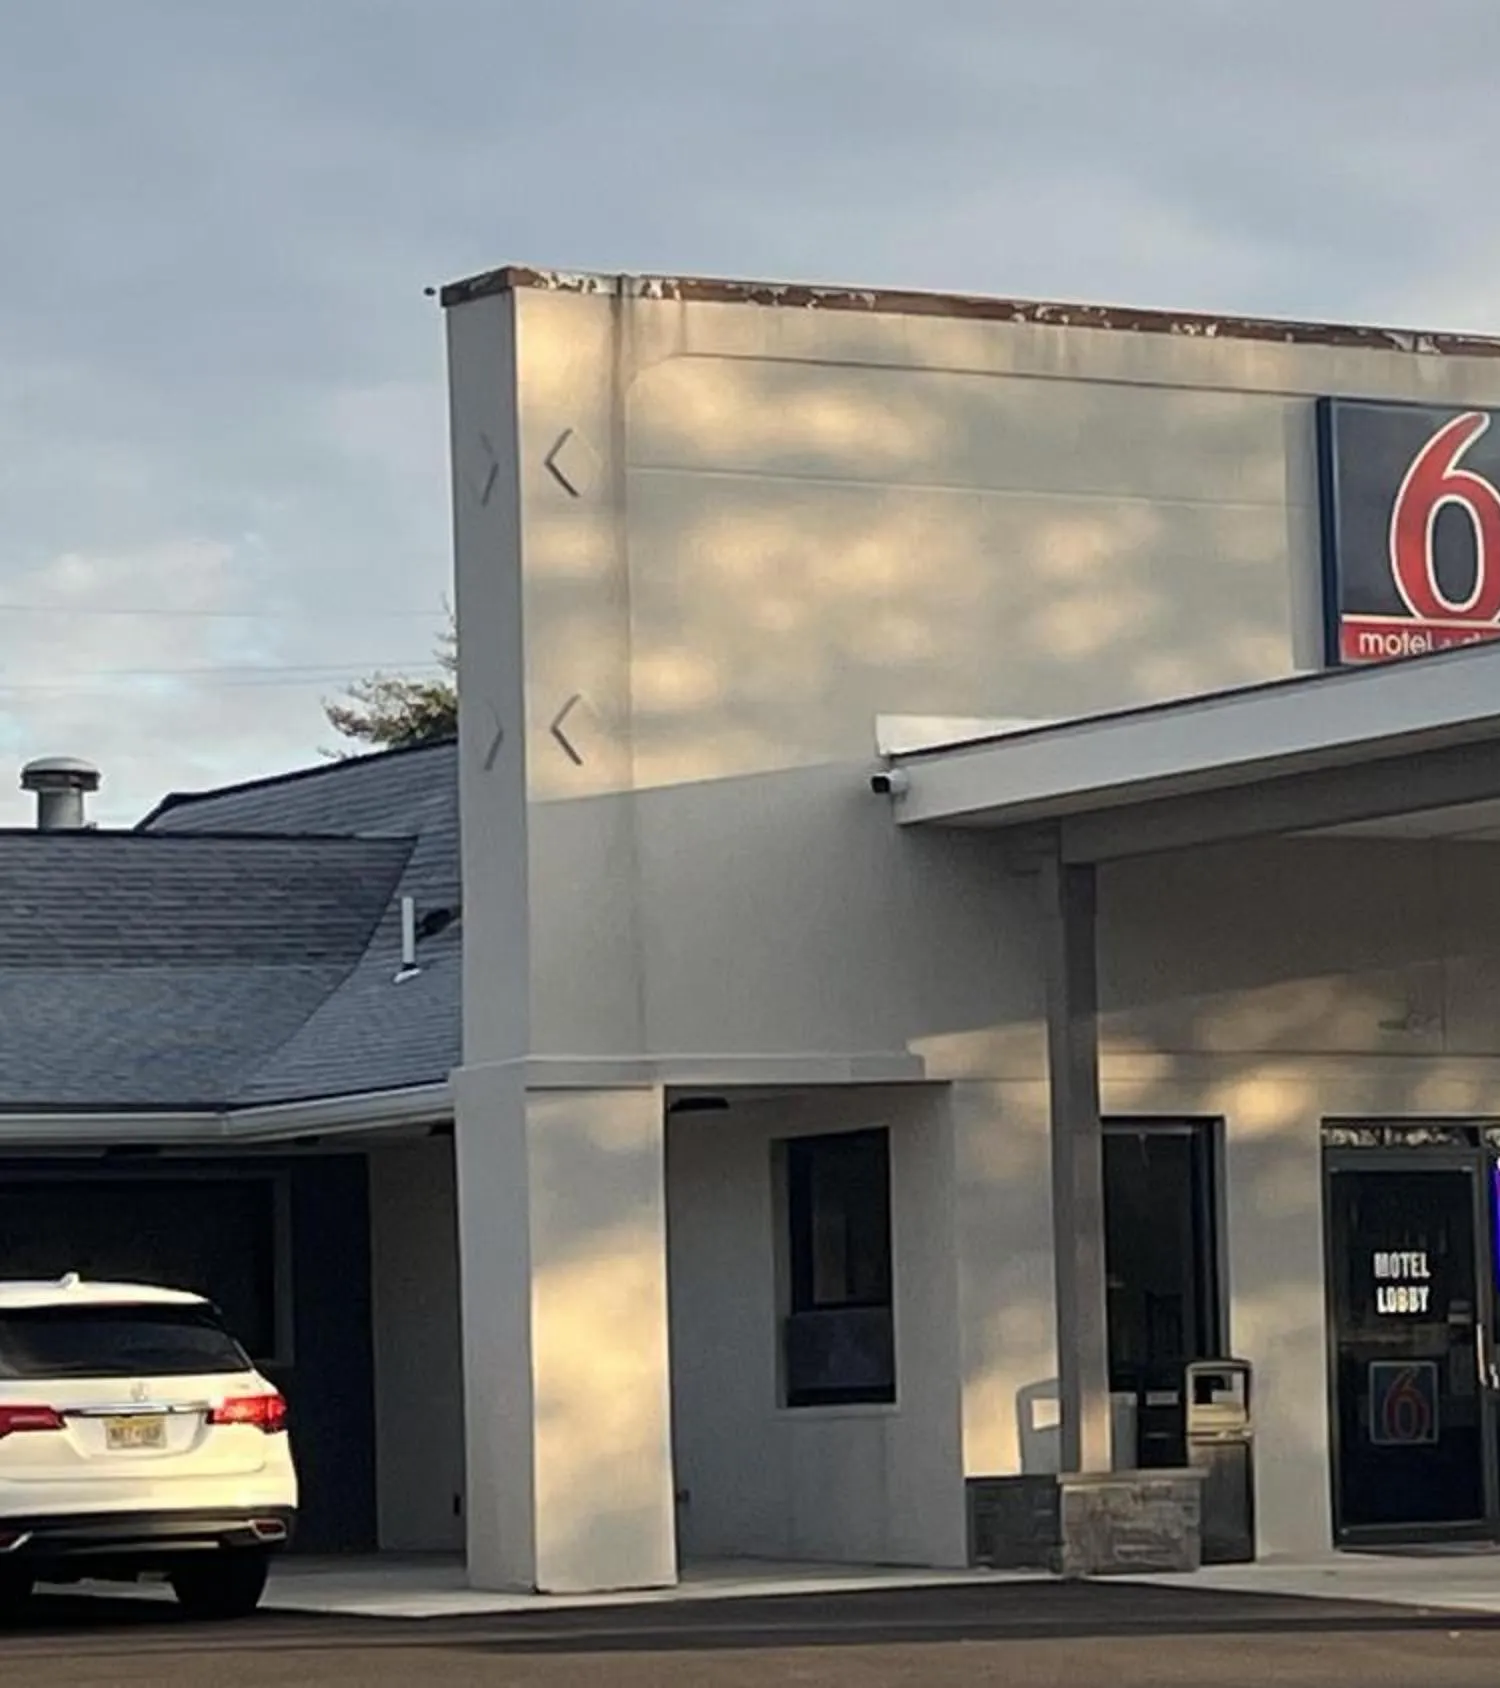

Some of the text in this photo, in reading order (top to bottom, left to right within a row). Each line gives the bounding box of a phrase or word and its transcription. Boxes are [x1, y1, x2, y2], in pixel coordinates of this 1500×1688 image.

[1359, 629, 1433, 656] motel
[1374, 1251, 1431, 1279] MOTEL
[1377, 1285, 1430, 1313] LOBBY
[1382, 1365, 1431, 1441] 6
